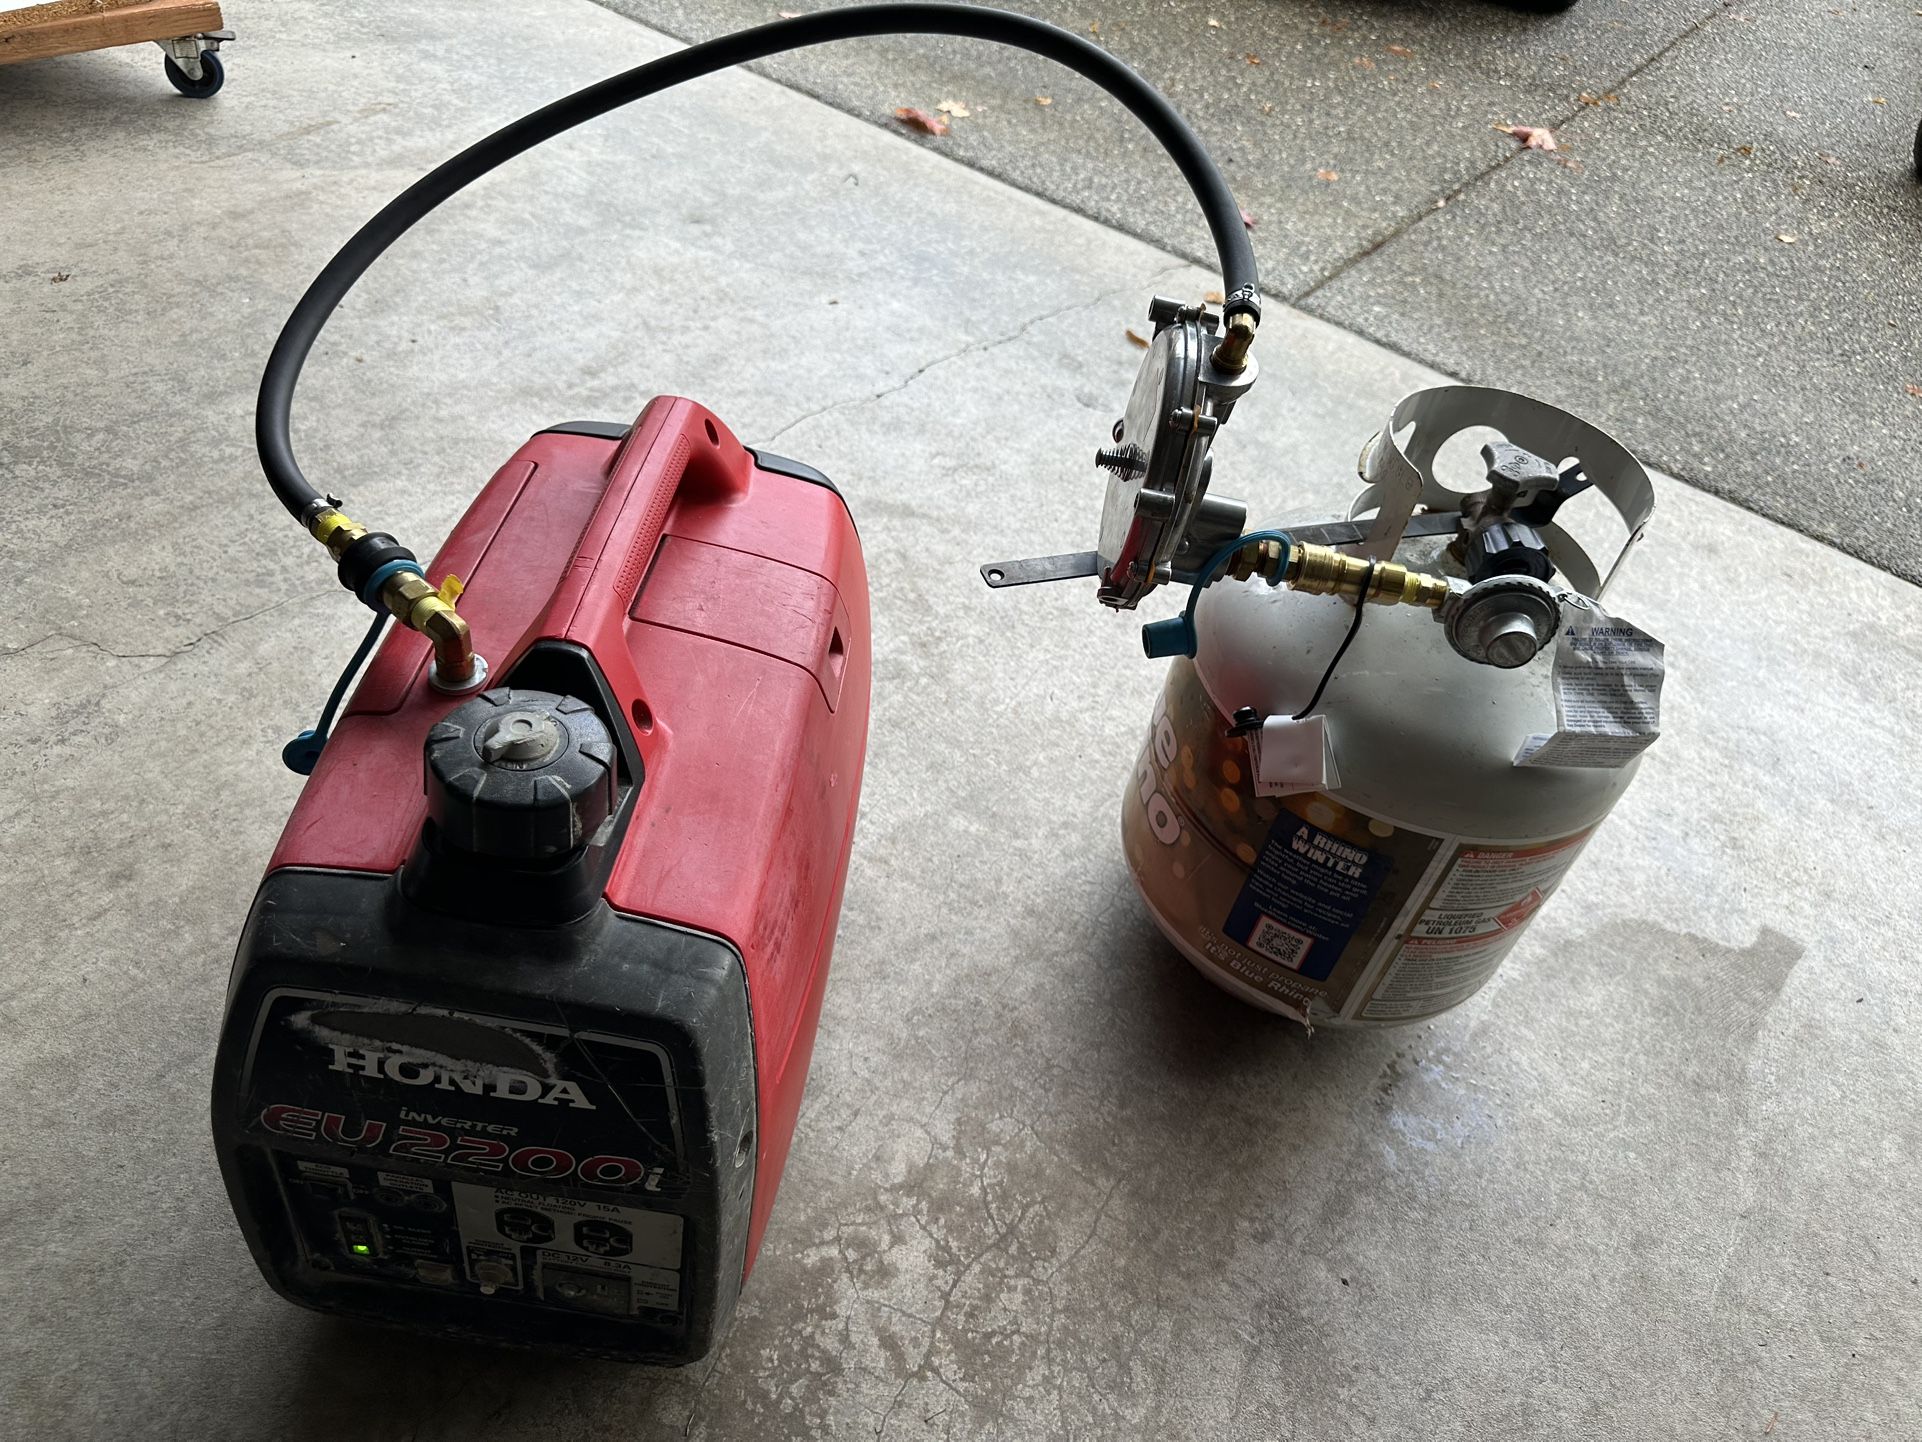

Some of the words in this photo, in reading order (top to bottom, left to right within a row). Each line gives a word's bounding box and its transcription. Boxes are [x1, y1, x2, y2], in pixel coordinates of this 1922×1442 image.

[1592, 627, 1634, 637] WARNING
[1296, 825, 1310, 839] A
[1312, 833, 1369, 865] RHINO
[1292, 836, 1363, 879] WINTER
[1419, 918, 1475, 927] PETROLEUM
[1475, 917, 1491, 925] GAS
[1438, 912, 1483, 920] LIQUEFIED
[1426, 926, 1443, 935] UN
[1448, 926, 1476, 935] 1075
[1220, 941, 1242, 960] not
[1242, 957, 1268, 975] just
[1229, 959, 1264, 983] Blue
[327, 1045, 597, 1110] HONDA
[500, 1195, 534, 1206] NEUTRAL
[518, 1190, 547, 1202] OUT
[554, 1196, 587, 1208] 120V
[596, 1203, 621, 1214] 15A
[541, 1250, 562, 1259] DC
[564, 1254, 591, 1264] 12V
